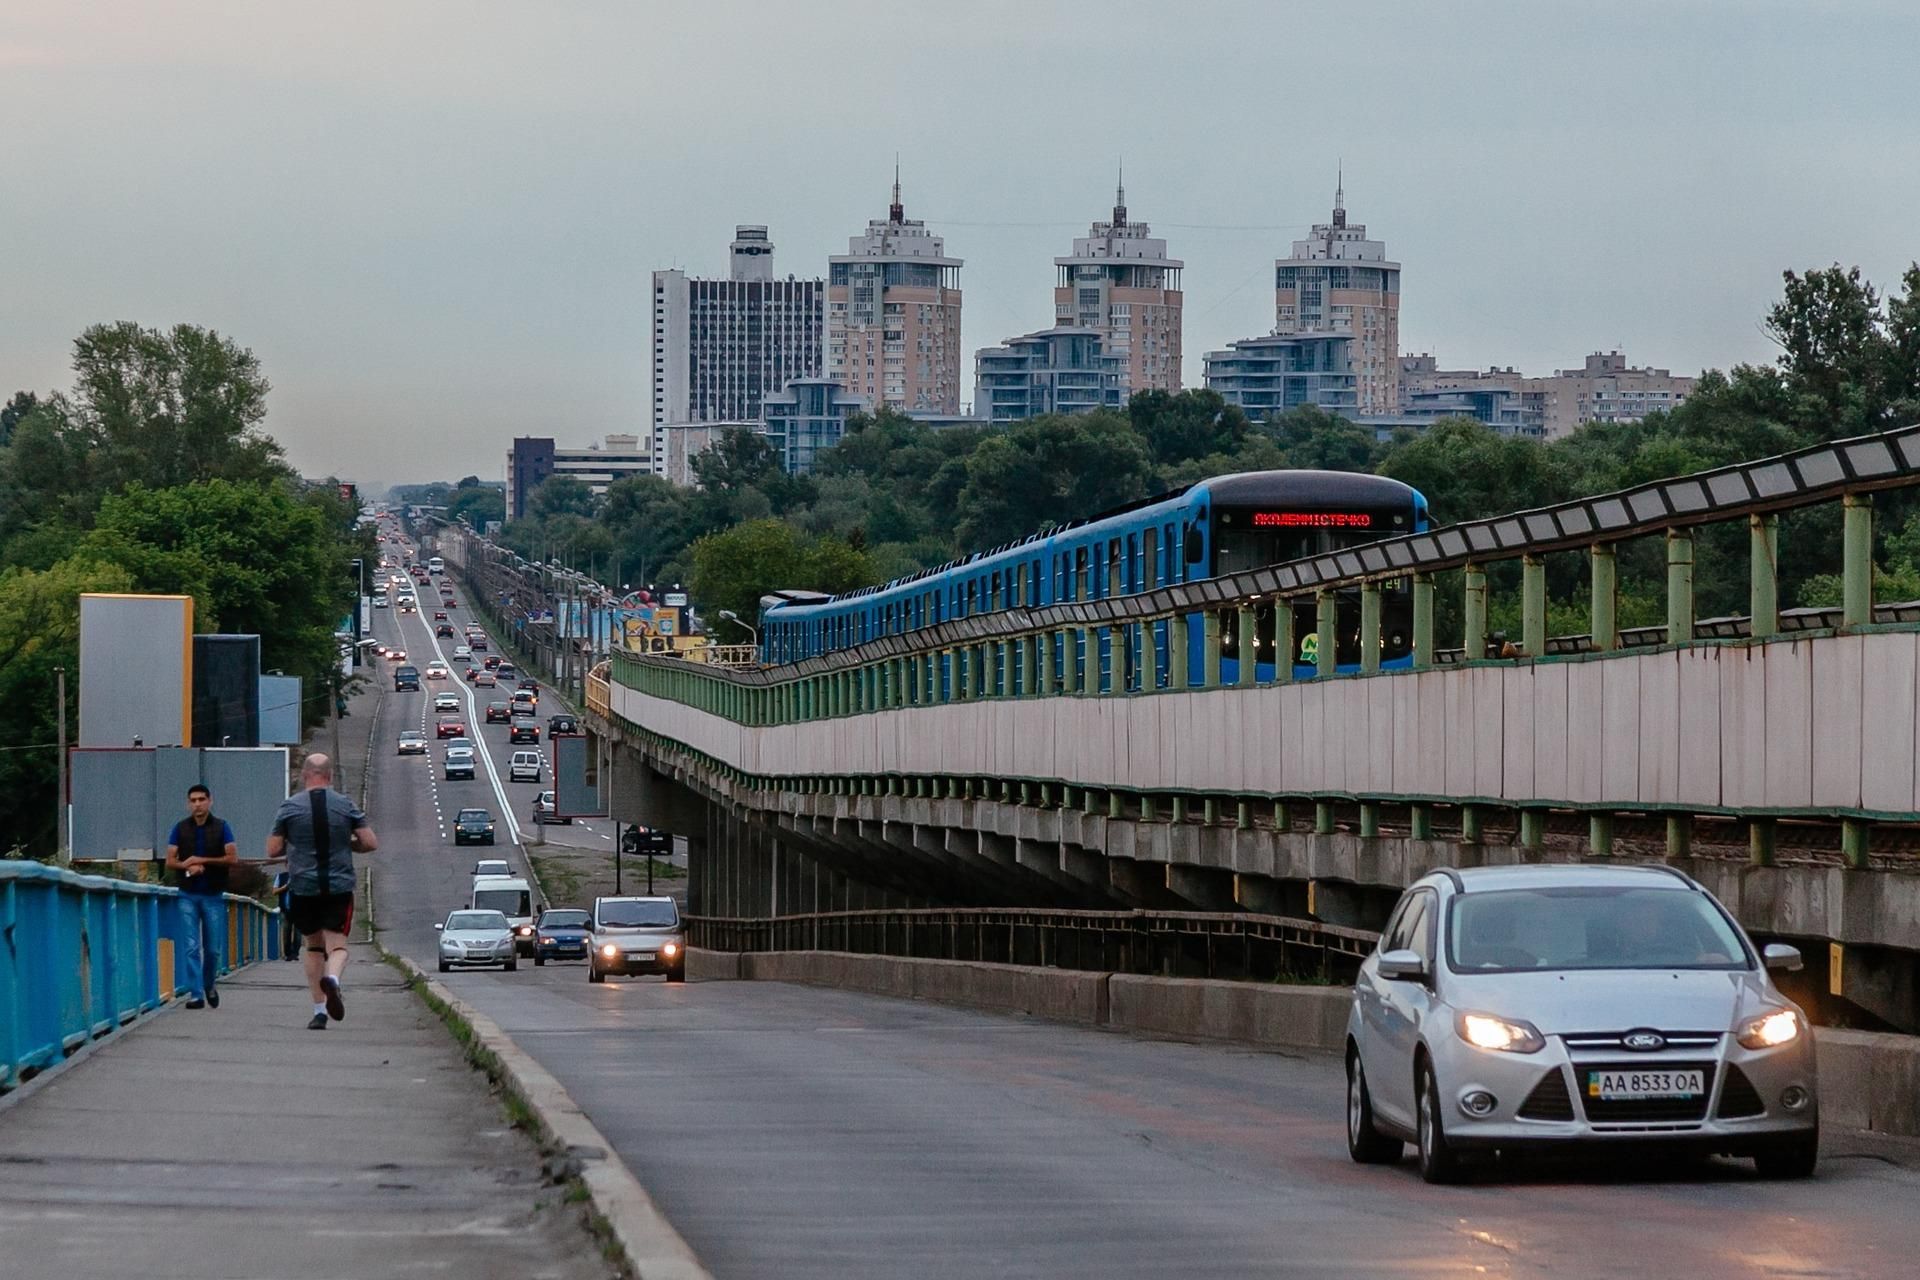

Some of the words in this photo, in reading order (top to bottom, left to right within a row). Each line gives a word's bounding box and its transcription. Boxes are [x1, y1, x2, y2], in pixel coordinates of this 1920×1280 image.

[1602, 1075, 1627, 1092] AA
[1631, 1074, 1670, 1091] 8533
[1675, 1073, 1700, 1090] OA
